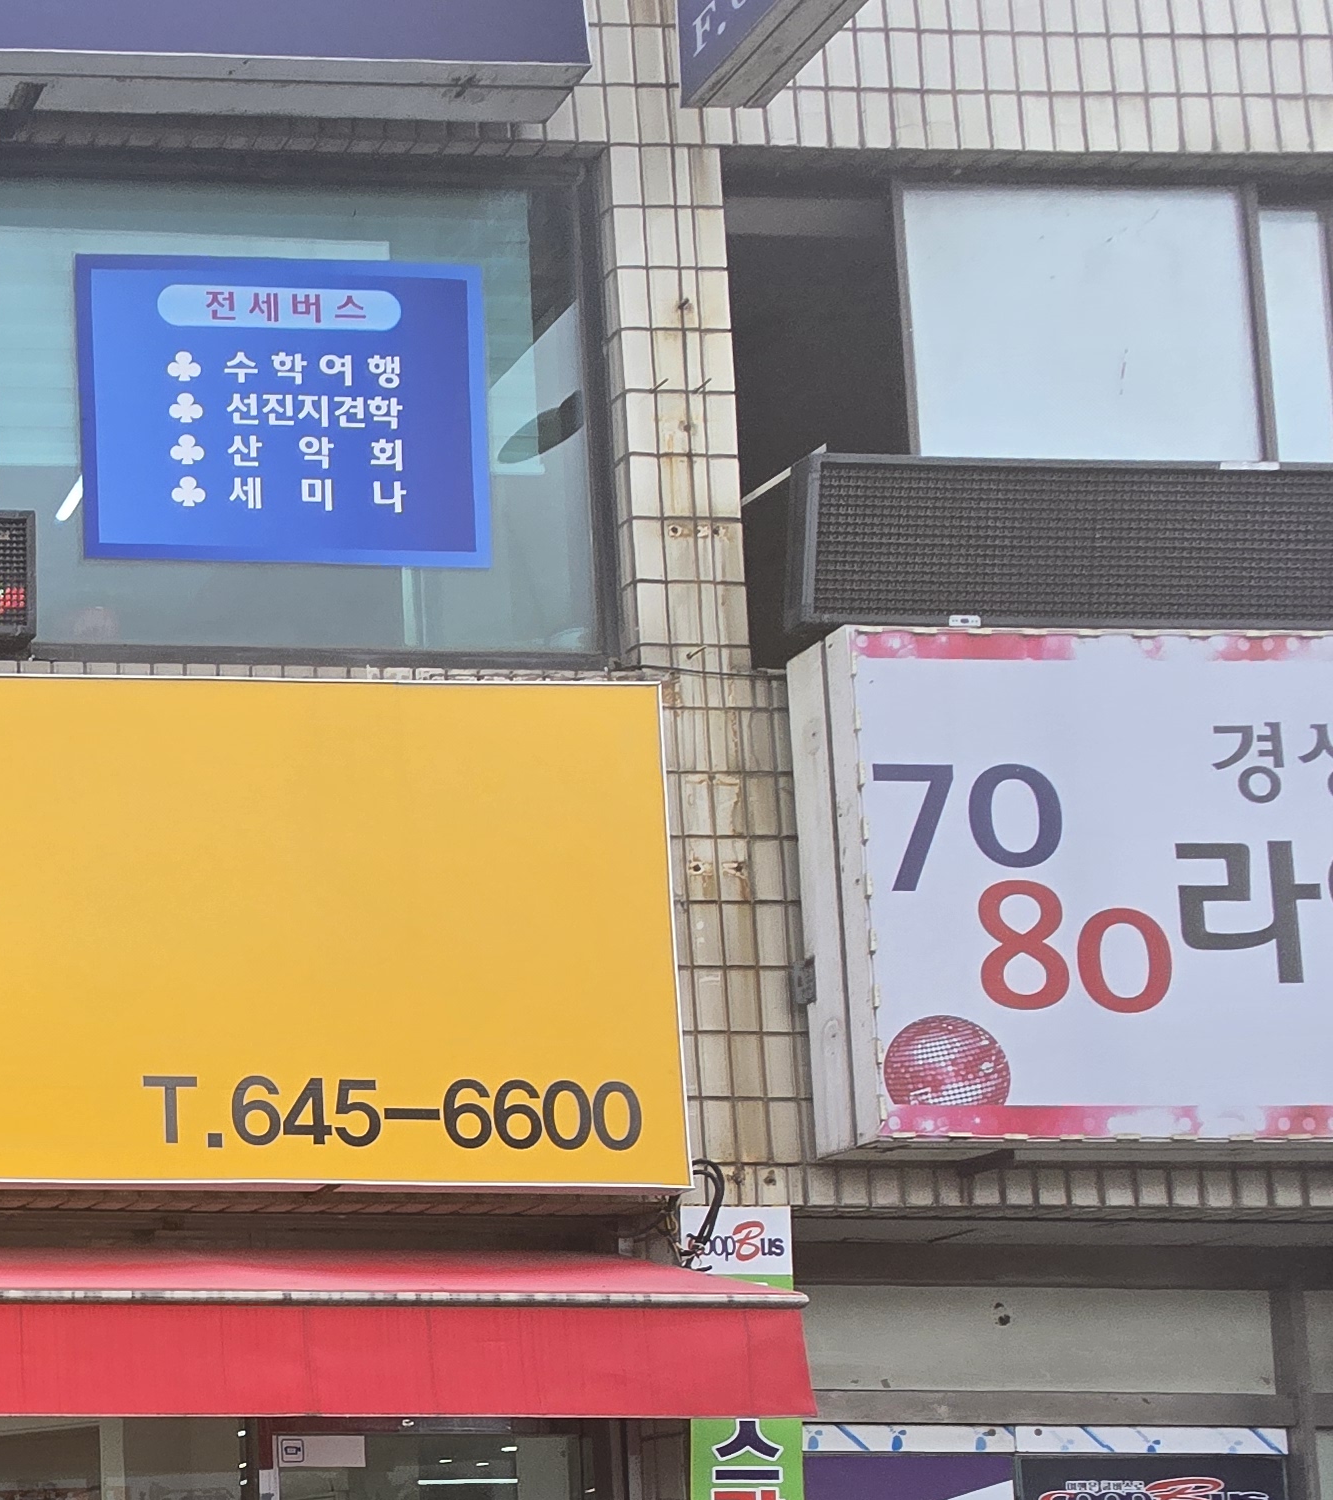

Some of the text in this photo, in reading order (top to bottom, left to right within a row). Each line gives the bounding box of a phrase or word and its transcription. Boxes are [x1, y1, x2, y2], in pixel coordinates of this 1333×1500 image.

[226, 392, 403, 429] 선진지견학
[872, 763, 1062, 892] 70
[978, 879, 1173, 1015] 80
[1174, 840, 1333, 984] 라
